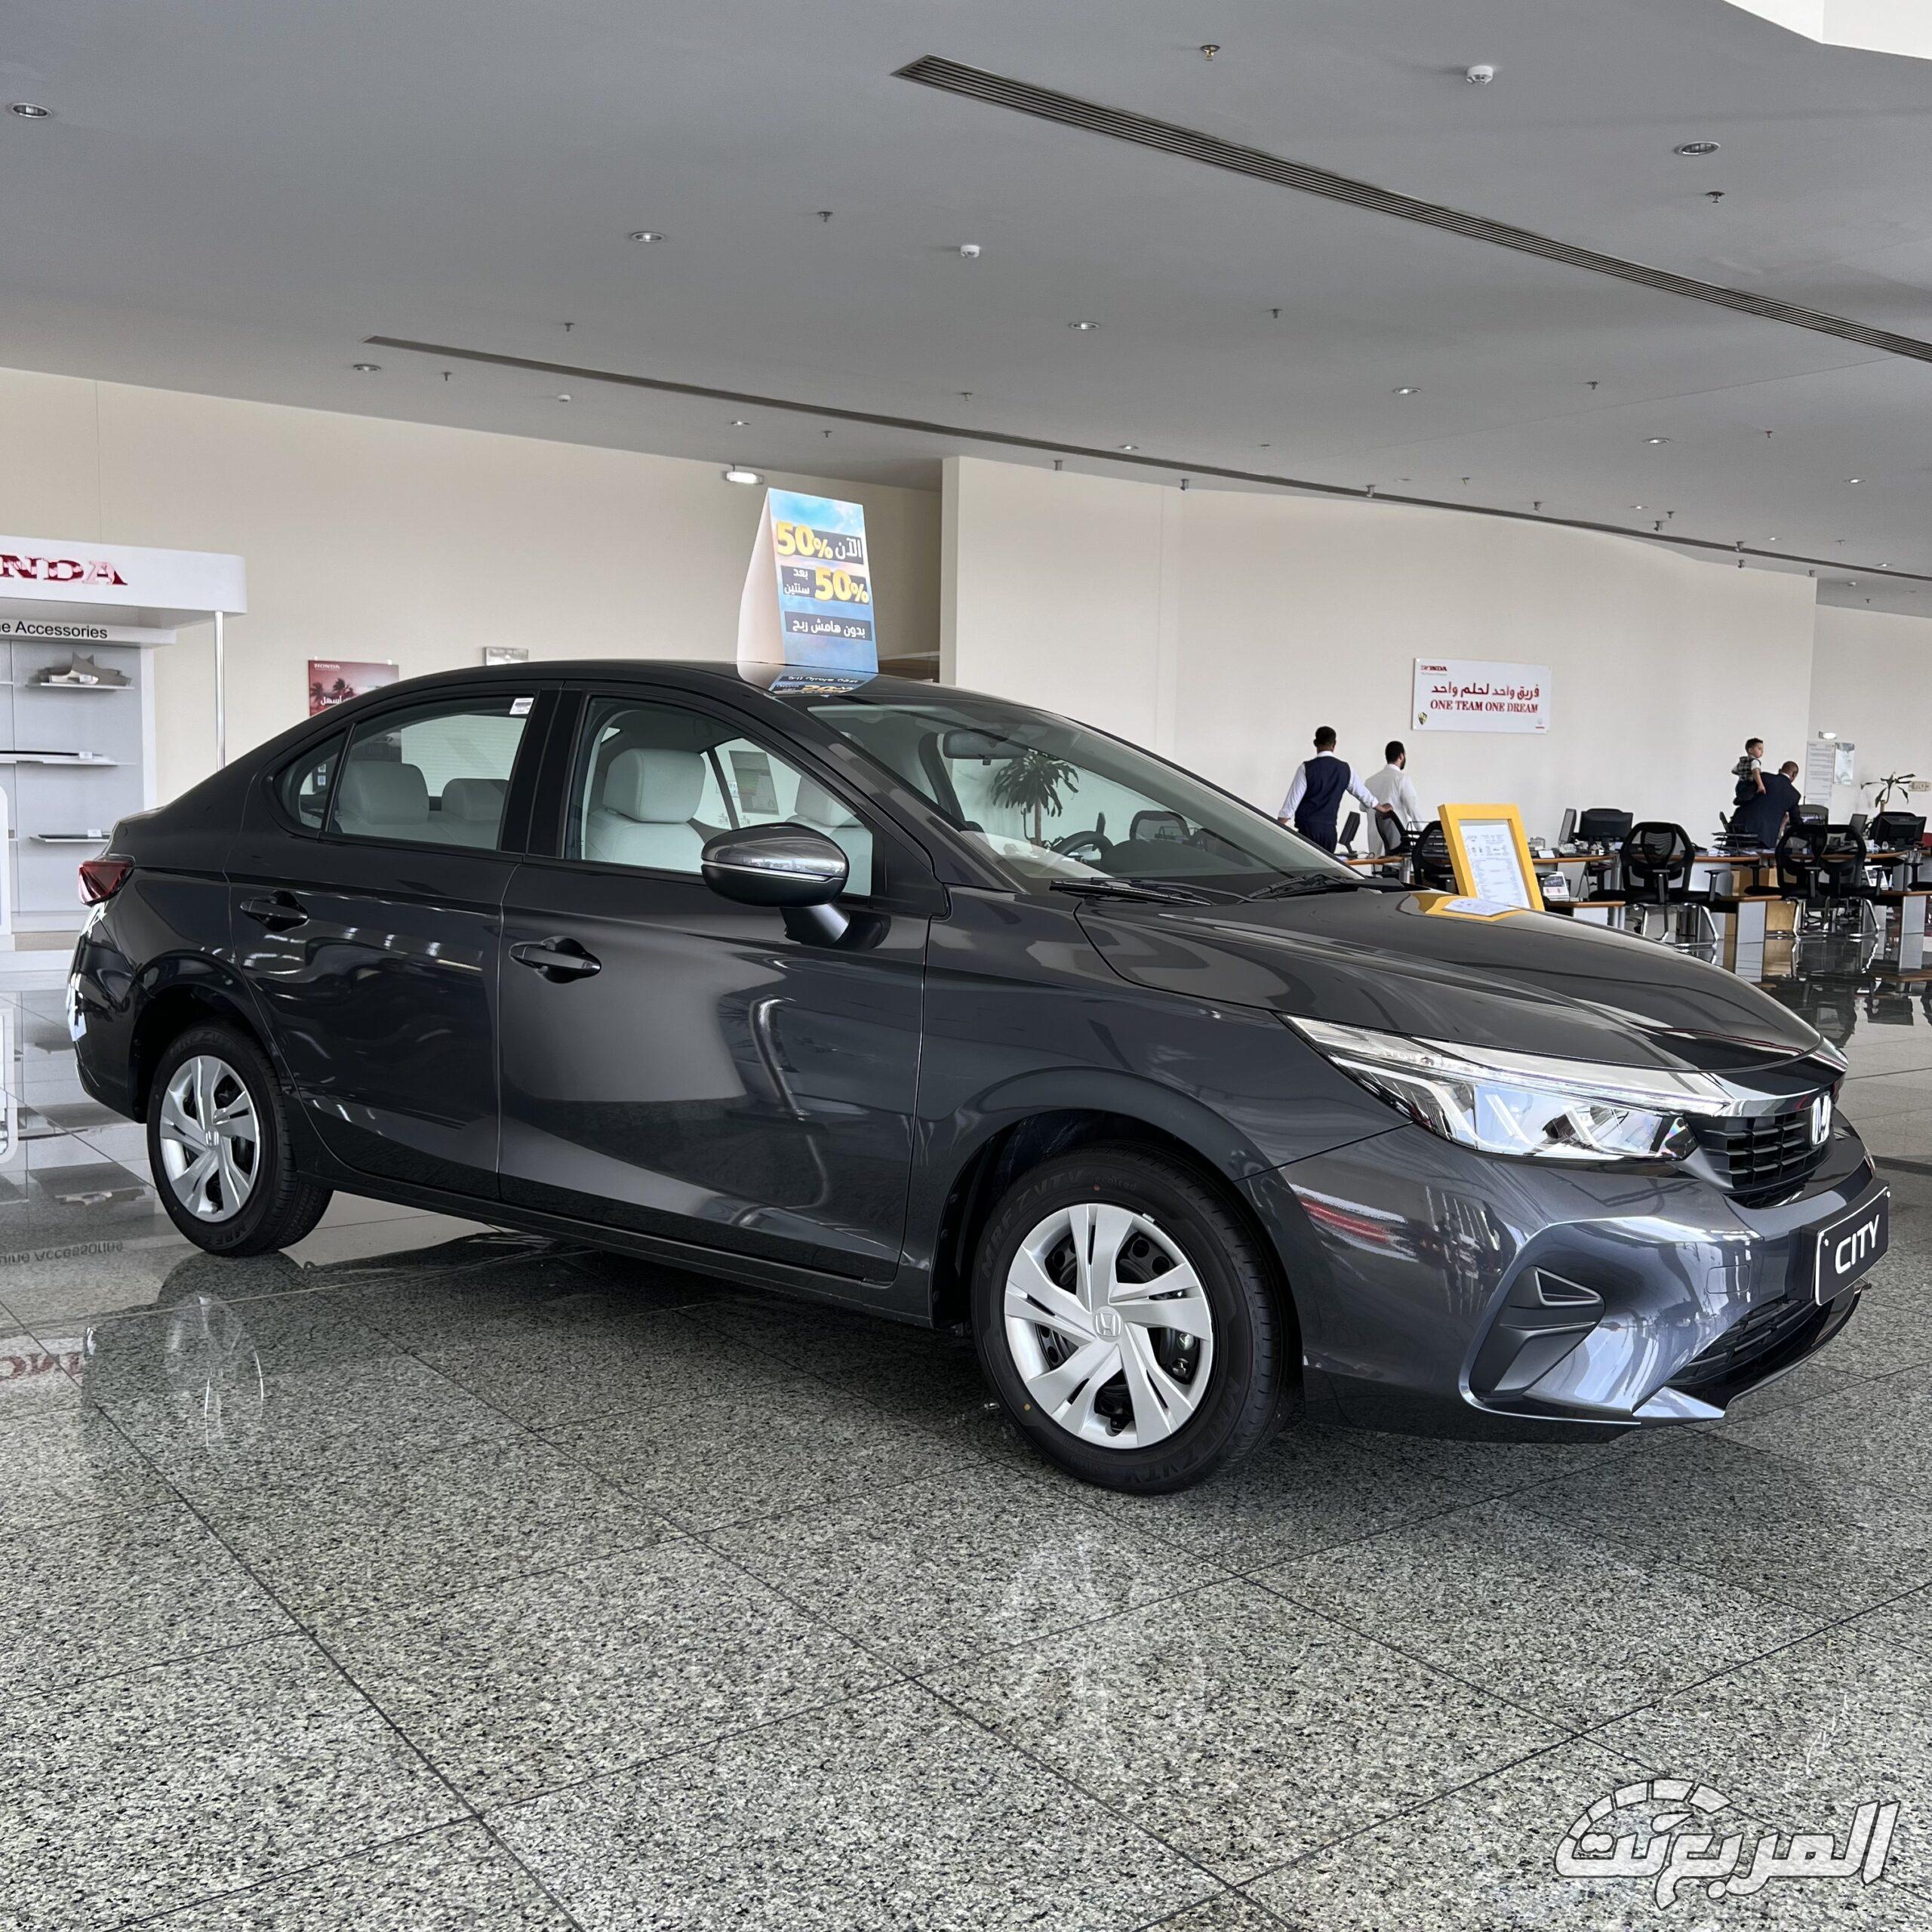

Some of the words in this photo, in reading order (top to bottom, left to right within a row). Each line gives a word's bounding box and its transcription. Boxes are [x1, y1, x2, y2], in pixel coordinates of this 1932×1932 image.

[777, 521, 833, 559] 50%
[835, 537, 863, 560] الآن
[793, 568, 808, 580] بعد
[783, 583, 810, 595] سنتين
[814, 567, 869, 603] 50%
[0, 623, 11, 632] e
[15, 620, 107, 638] Accessories
[792, 620, 808, 632] ربح
[811, 618, 841, 634] هامش
[843, 626, 866, 638] بدون
[1431, 681, 1457, 697] واحد
[1460, 682, 1489, 697] لحلم
[1492, 685, 1515, 700] واحد
[1517, 684, 1540, 700] فريق
[1430, 700, 1453, 709] ONE
[1455, 700, 1482, 712] TEAM
[1485, 702, 1505, 712] ONE
[1507, 703, 1538, 713] DREAM
[1835, 1214, 1879, 1275] CITY
